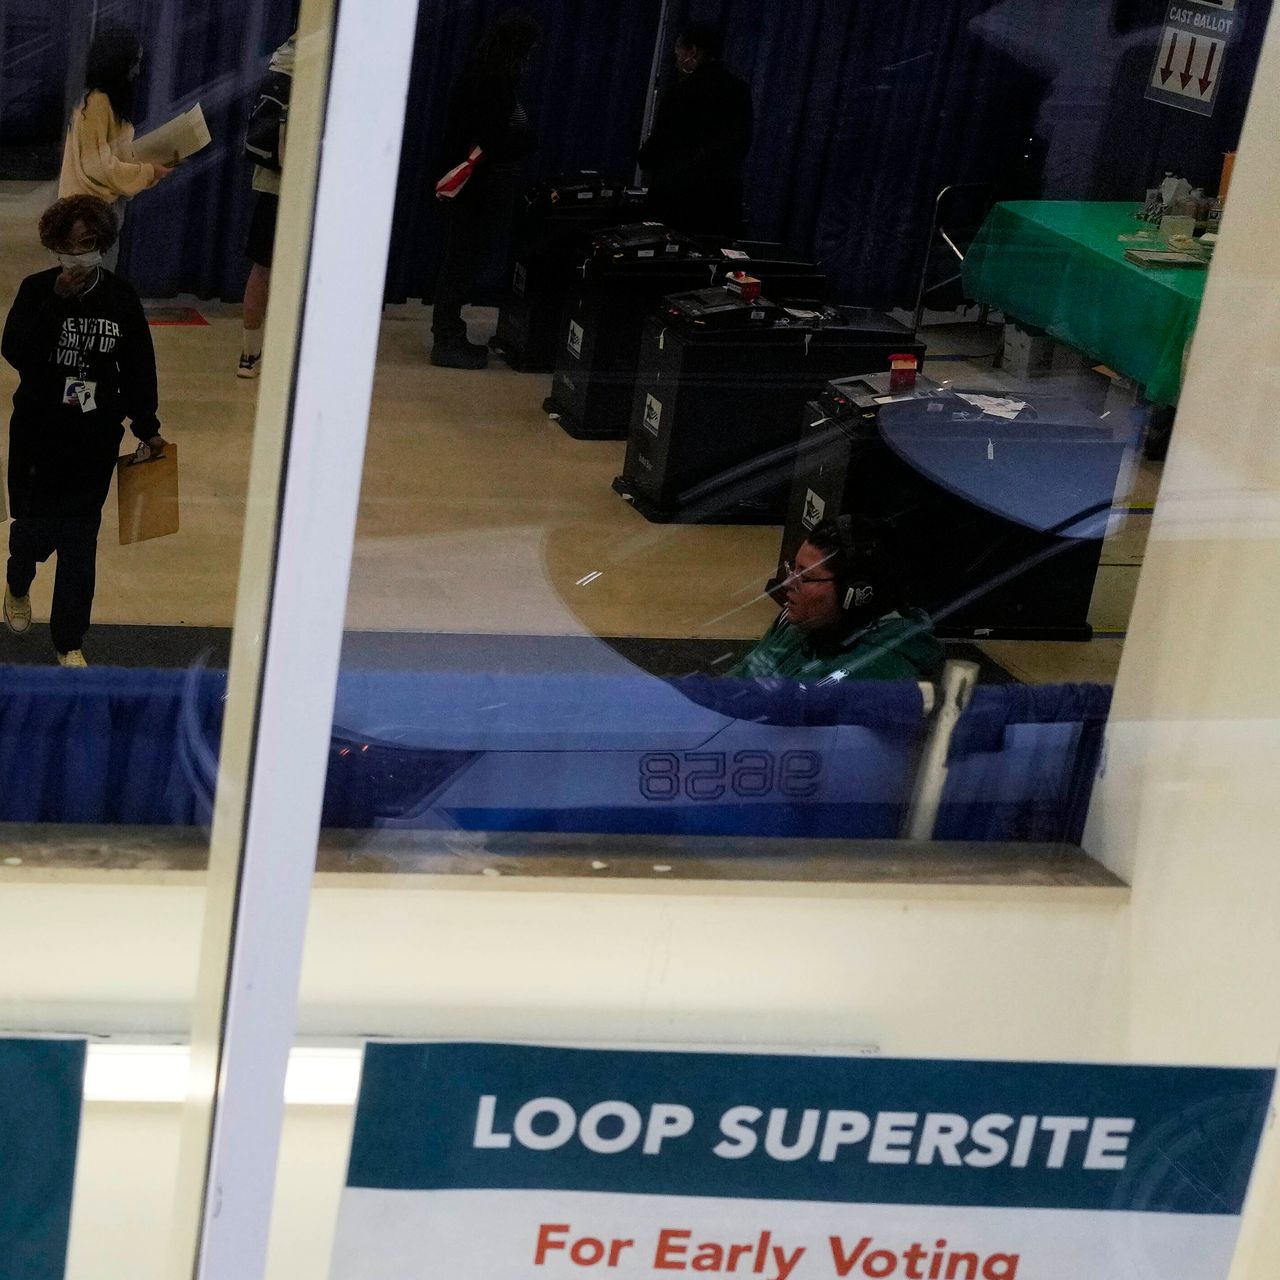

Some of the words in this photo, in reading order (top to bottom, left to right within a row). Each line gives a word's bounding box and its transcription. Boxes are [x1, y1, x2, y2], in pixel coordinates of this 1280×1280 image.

[1169, 6, 1193, 24] CAST
[1193, 13, 1233, 33] BALLOT
[473, 1095, 694, 1154] LOOP
[713, 1106, 1134, 1169] SUPERSITE
[535, 1224, 634, 1267] For
